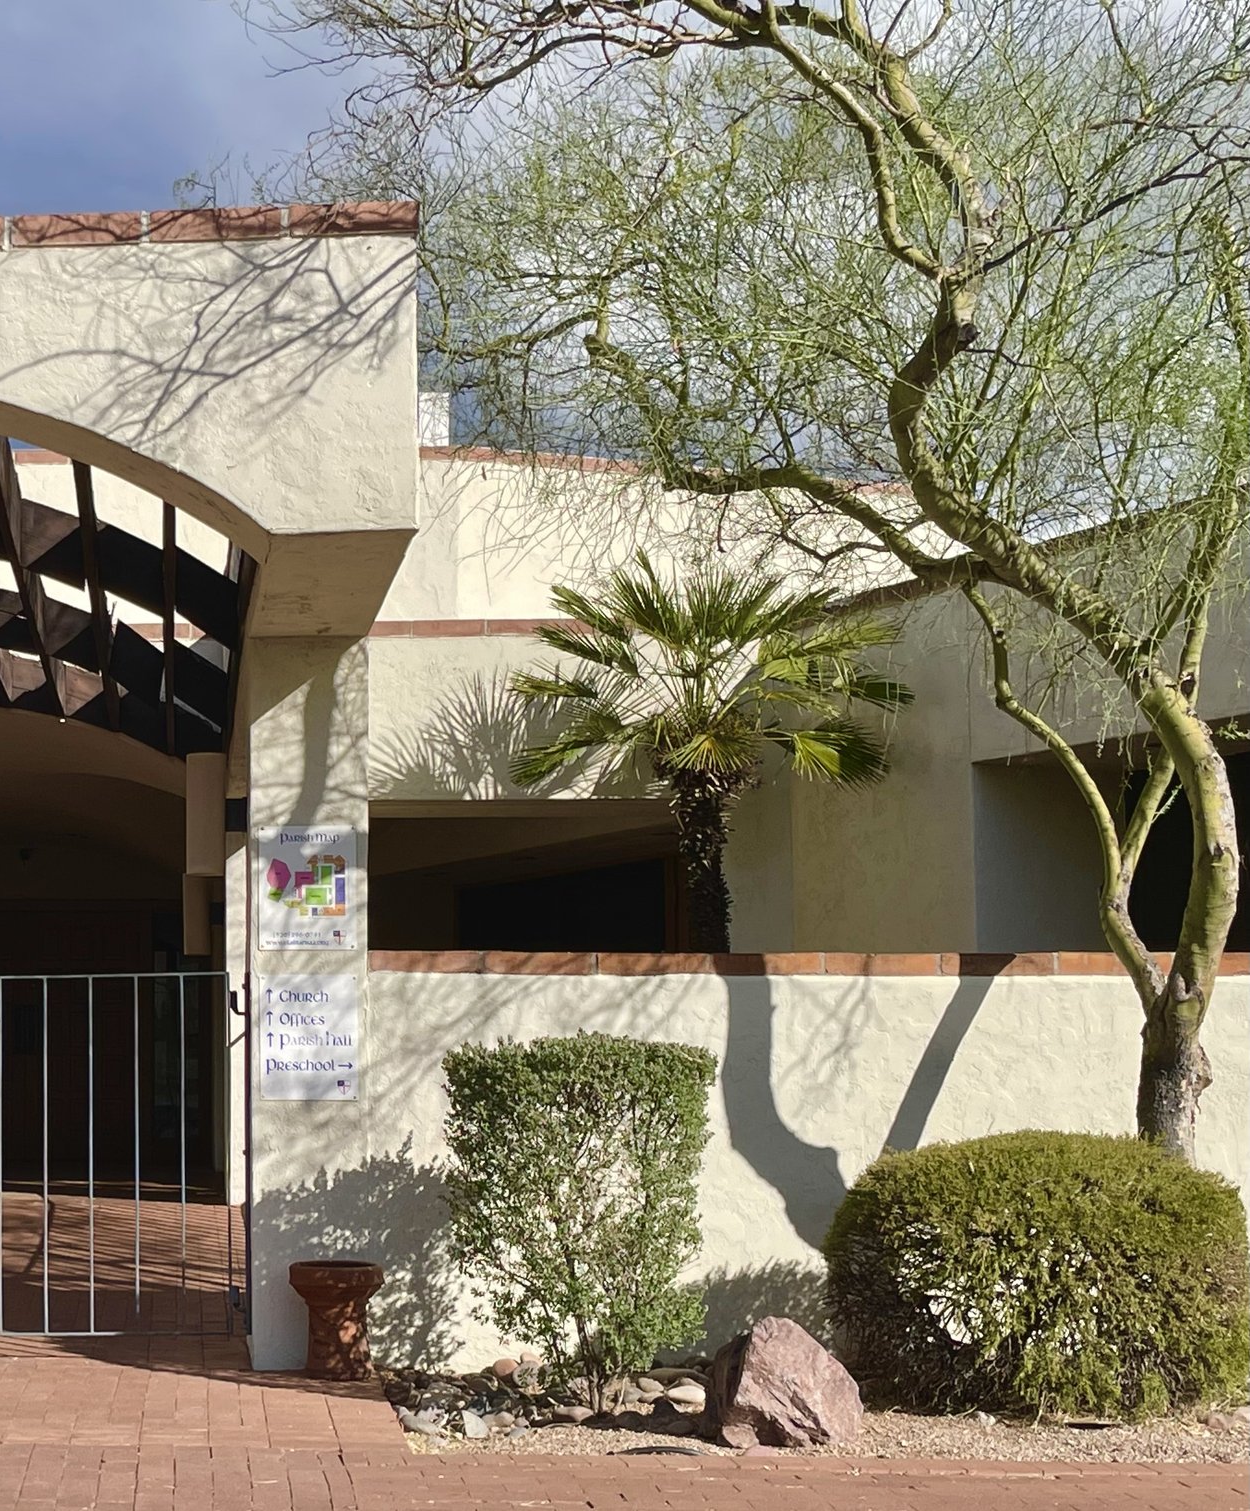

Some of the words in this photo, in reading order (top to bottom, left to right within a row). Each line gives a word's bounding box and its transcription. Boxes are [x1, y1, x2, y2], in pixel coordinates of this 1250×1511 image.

[315, 833, 340, 844] Map
[279, 990, 329, 1003] Church
[279, 1012, 325, 1027] Offices
[279, 1033, 324, 1050] Parish
[266, 1058, 336, 1075] Preschool
